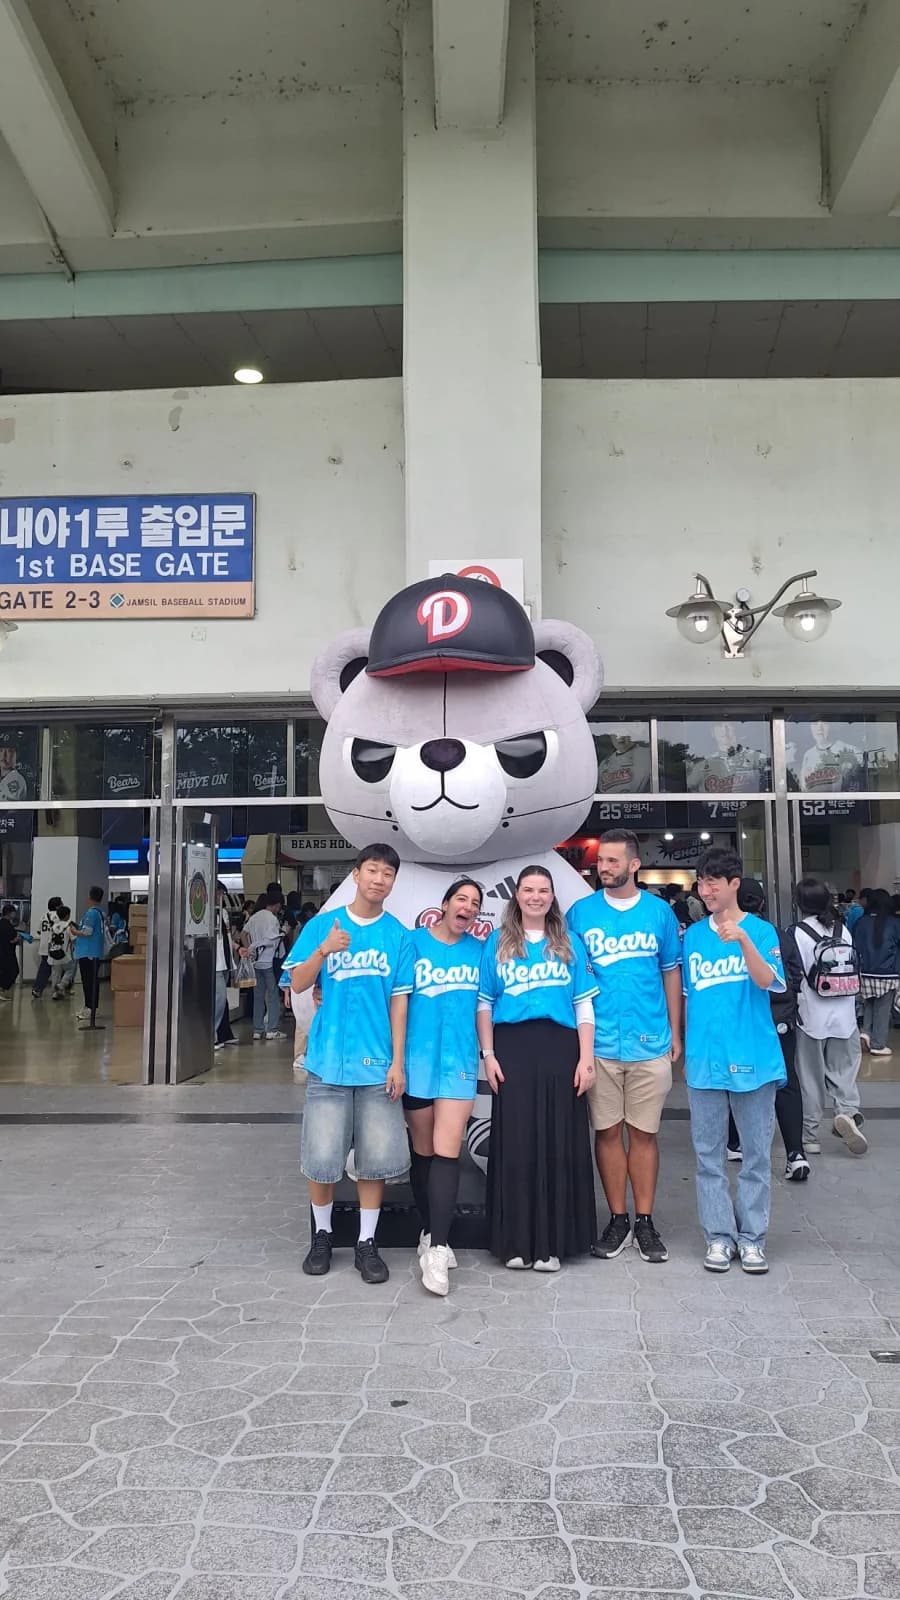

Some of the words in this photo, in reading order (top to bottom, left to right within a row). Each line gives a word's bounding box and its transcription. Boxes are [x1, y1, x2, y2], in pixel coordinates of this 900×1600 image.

[0, 506, 129, 549] 내야1루
[140, 504, 247, 548] 출입문
[16, 555, 55, 578] 1st
[70, 553, 141, 577] BASE
[155, 552, 229, 576] GATE
[0, 591, 53, 610] GATE
[65, 590, 100, 609] 2-3
[126, 599, 158, 607] JAMSIL
[161, 598, 204, 607] BASEBALL
[207, 597, 247, 606] STADIUM
[416, 589, 472, 644] D
[107, 775, 141, 792] Bears
[176, 776, 209, 790] MOVE
[211, 773, 228, 786] ON
[252, 774, 287, 791] Bears
[600, 803, 621, 819] 25
[707, 801, 719, 818] 7
[802, 800, 826, 815] 52
[291, 840, 327, 849] BEARS
[329, 840, 355, 849] HOU
[584, 927, 658, 967] Bears
[327, 948, 391, 982] Bears
[497, 959, 572, 997] Bears
